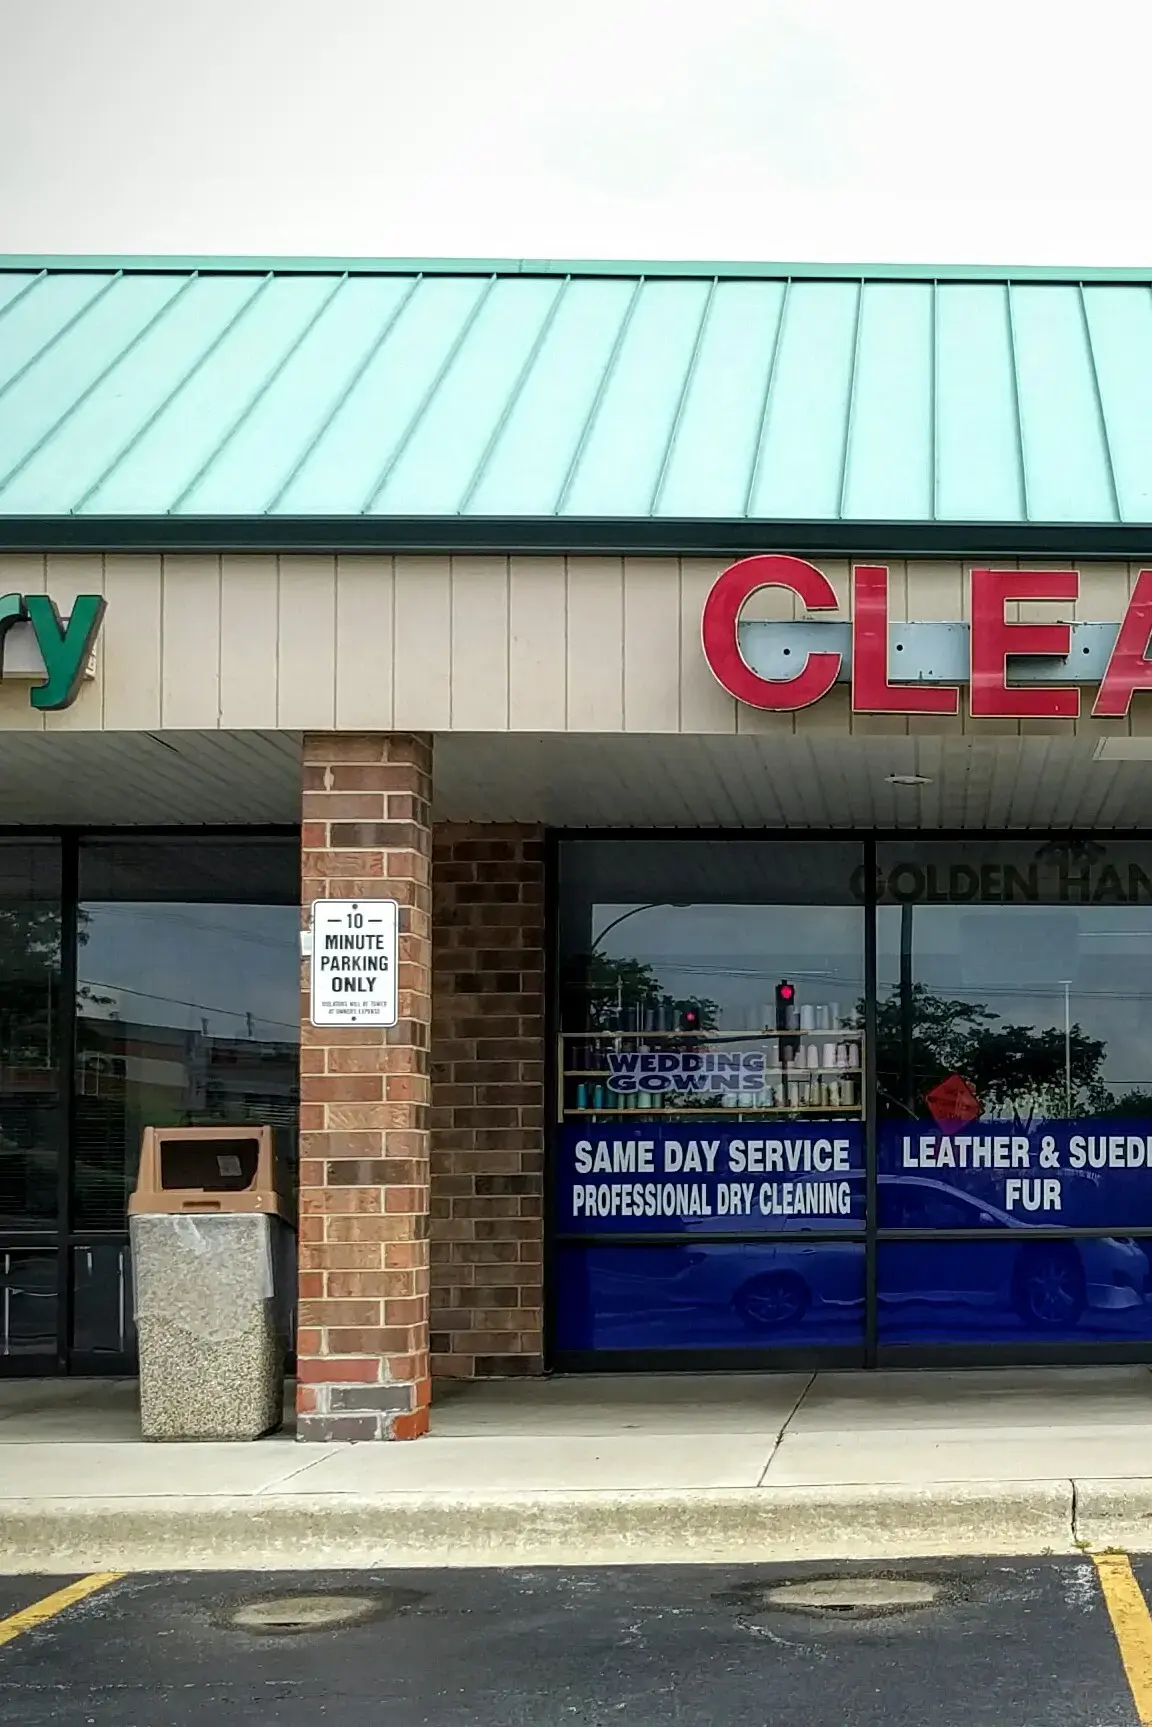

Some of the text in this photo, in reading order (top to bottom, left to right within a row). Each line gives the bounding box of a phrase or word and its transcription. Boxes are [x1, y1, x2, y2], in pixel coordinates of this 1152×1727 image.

[850, 863, 1038, 902] GOLDEN
[347, 913, 363, 928] 10
[325, 934, 385, 950] MINUTE
[320, 955, 389, 971] PARKING
[331, 976, 377, 992] ONLY
[608, 1053, 765, 1073] WEDDING
[608, 1074, 765, 1091] GOWNS
[575, 1139, 850, 1173] SAME DAY SERVICE
[903, 1136, 1029, 1167] LEATHER
[1039, 1135, 1060, 1168] &
[573, 1181, 850, 1216] PROFESSIONAL DRY CLEANING
[1005, 1179, 1062, 1210] FUR
